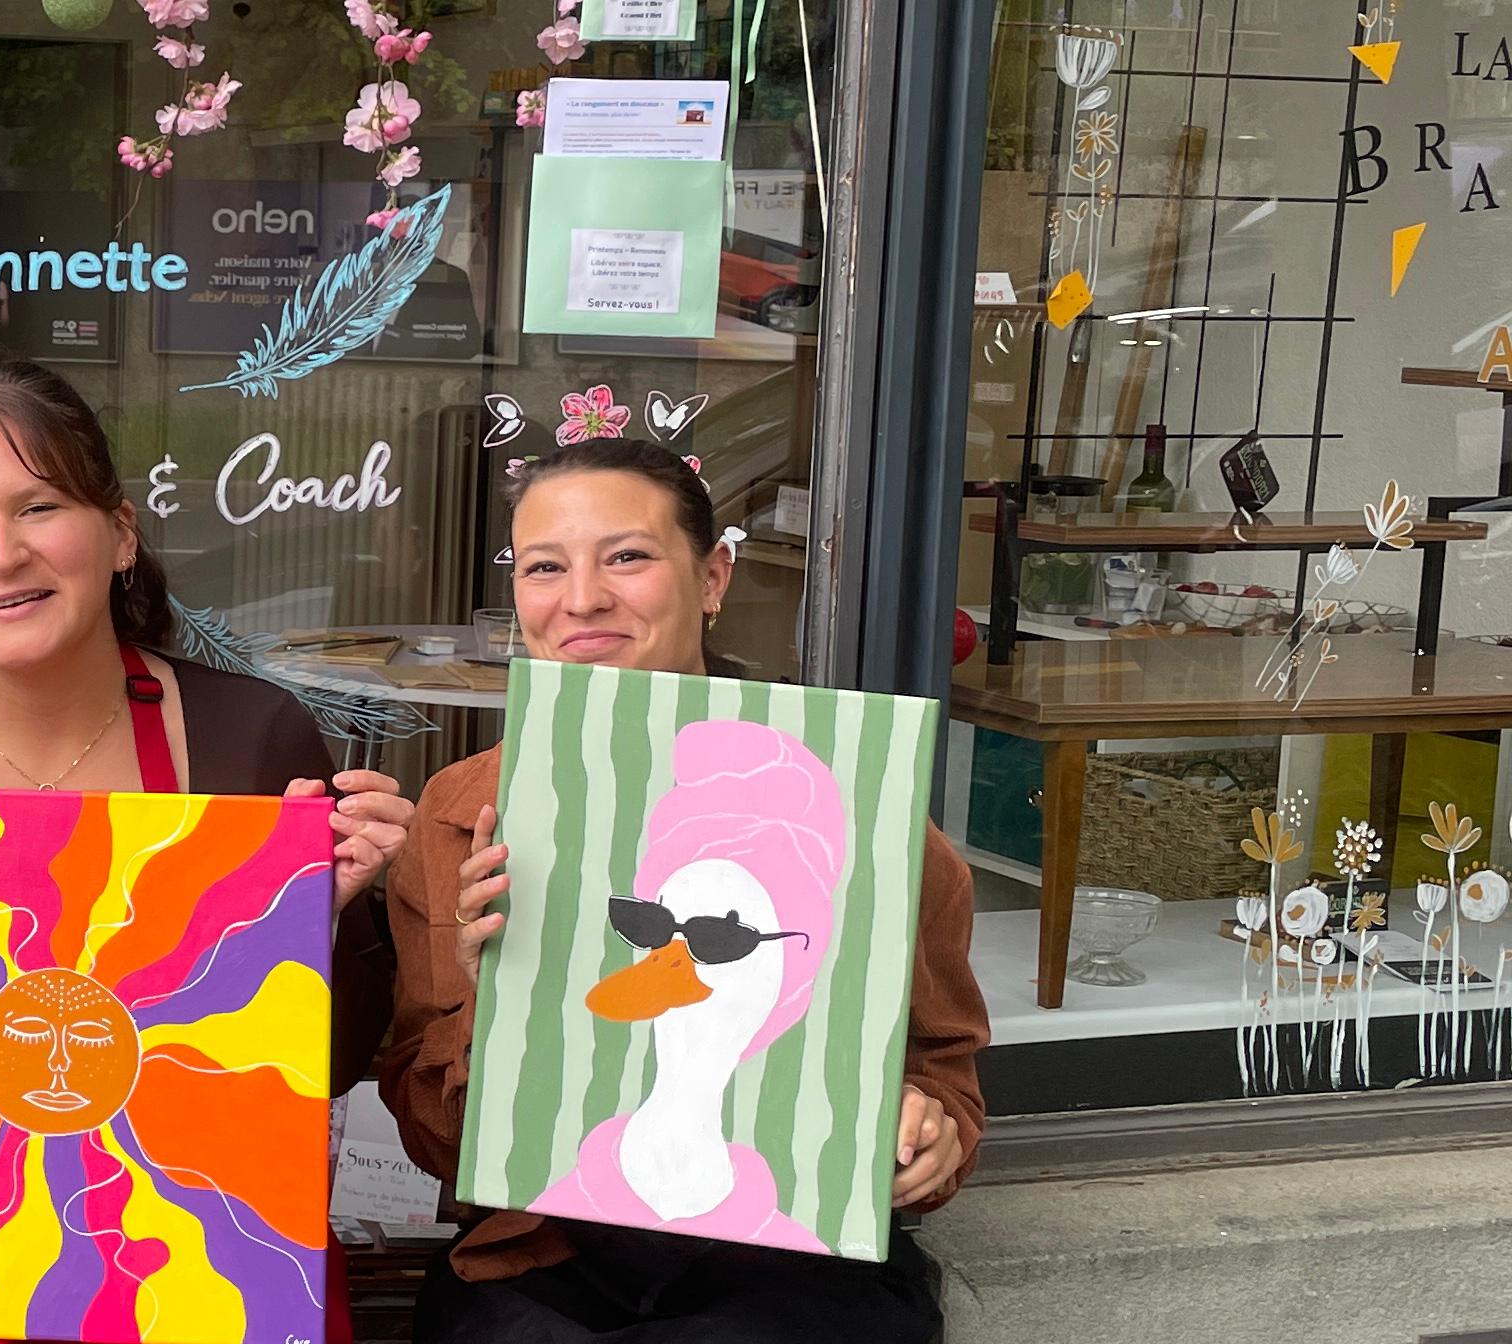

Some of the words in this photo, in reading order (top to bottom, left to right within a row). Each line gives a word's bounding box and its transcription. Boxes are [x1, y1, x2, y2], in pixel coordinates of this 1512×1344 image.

[588, 298, 653, 309] Servez-vous
[147, 453, 180, 519] &
[215, 432, 402, 526] Coach
